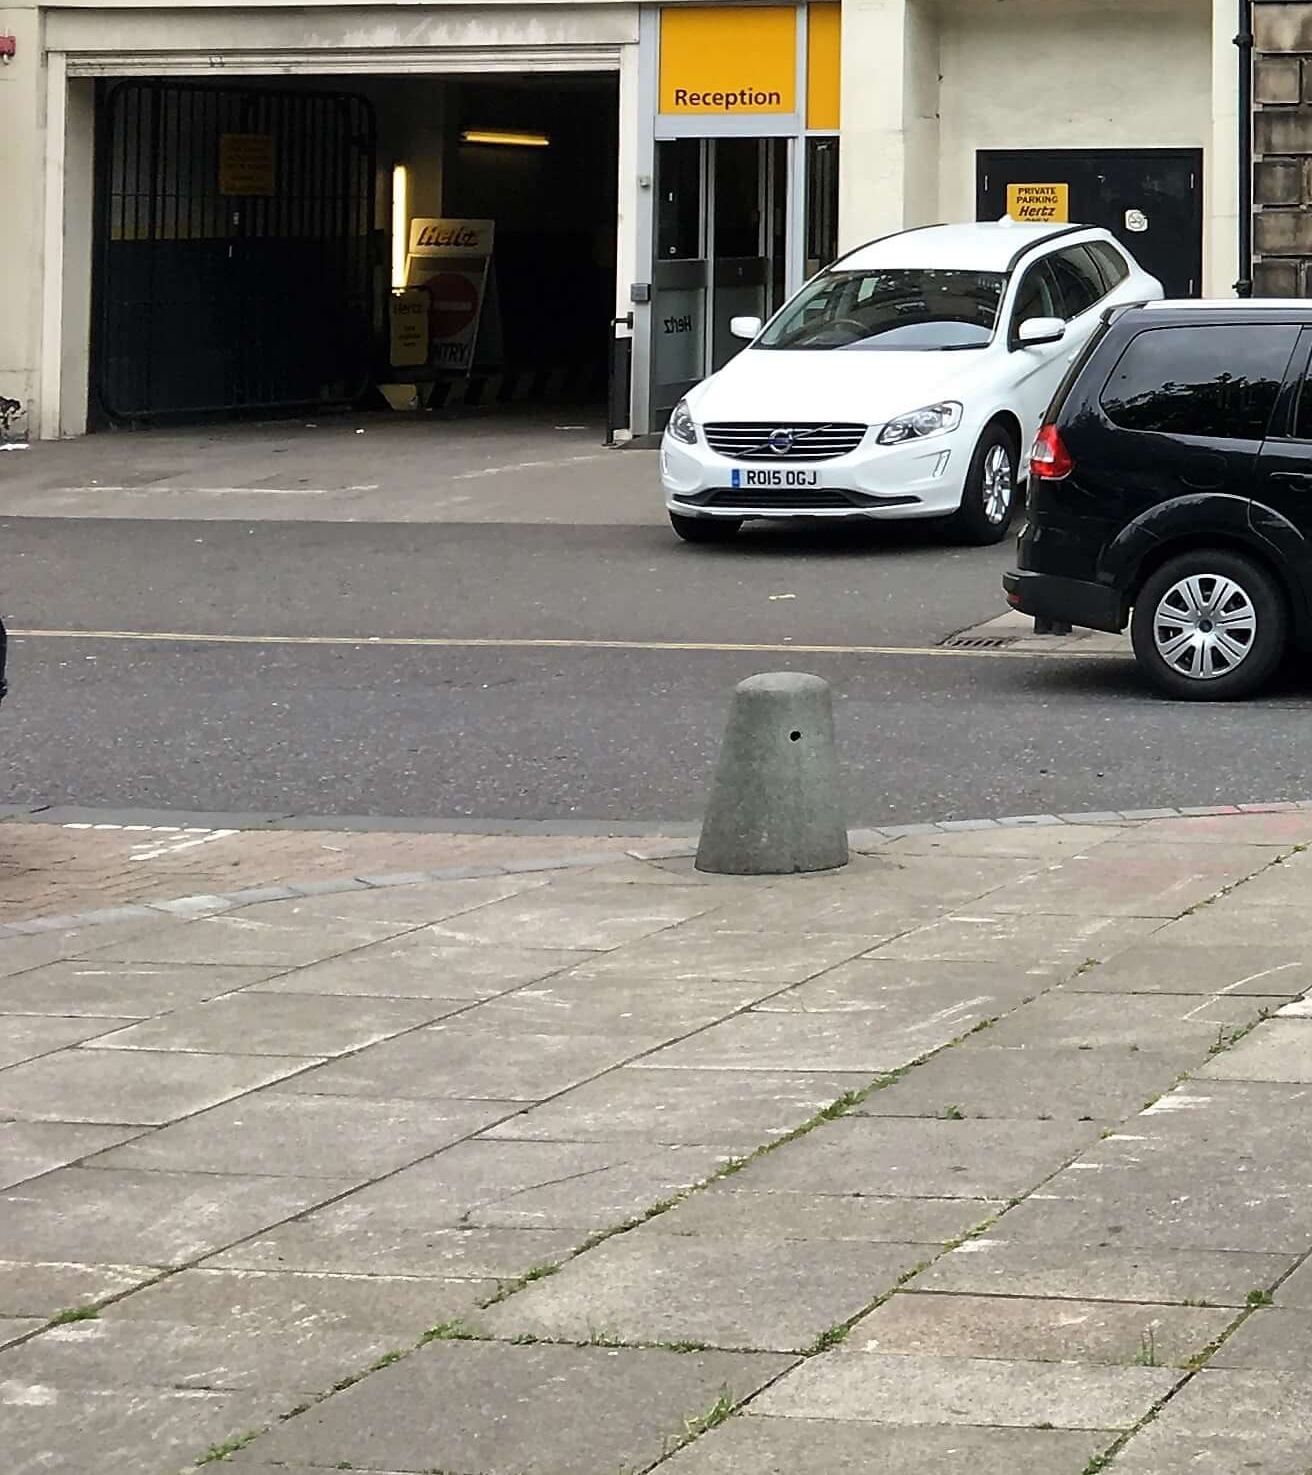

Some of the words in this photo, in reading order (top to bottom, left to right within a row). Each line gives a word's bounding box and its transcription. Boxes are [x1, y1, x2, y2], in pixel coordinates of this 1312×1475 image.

[675, 87, 781, 110] Reception
[1018, 187, 1056, 195] PRIVATE
[1016, 196, 1058, 204] PARKING
[1018, 206, 1056, 216] Hertz
[747, 470, 781, 485] RO15
[786, 470, 816, 485] OGJ
